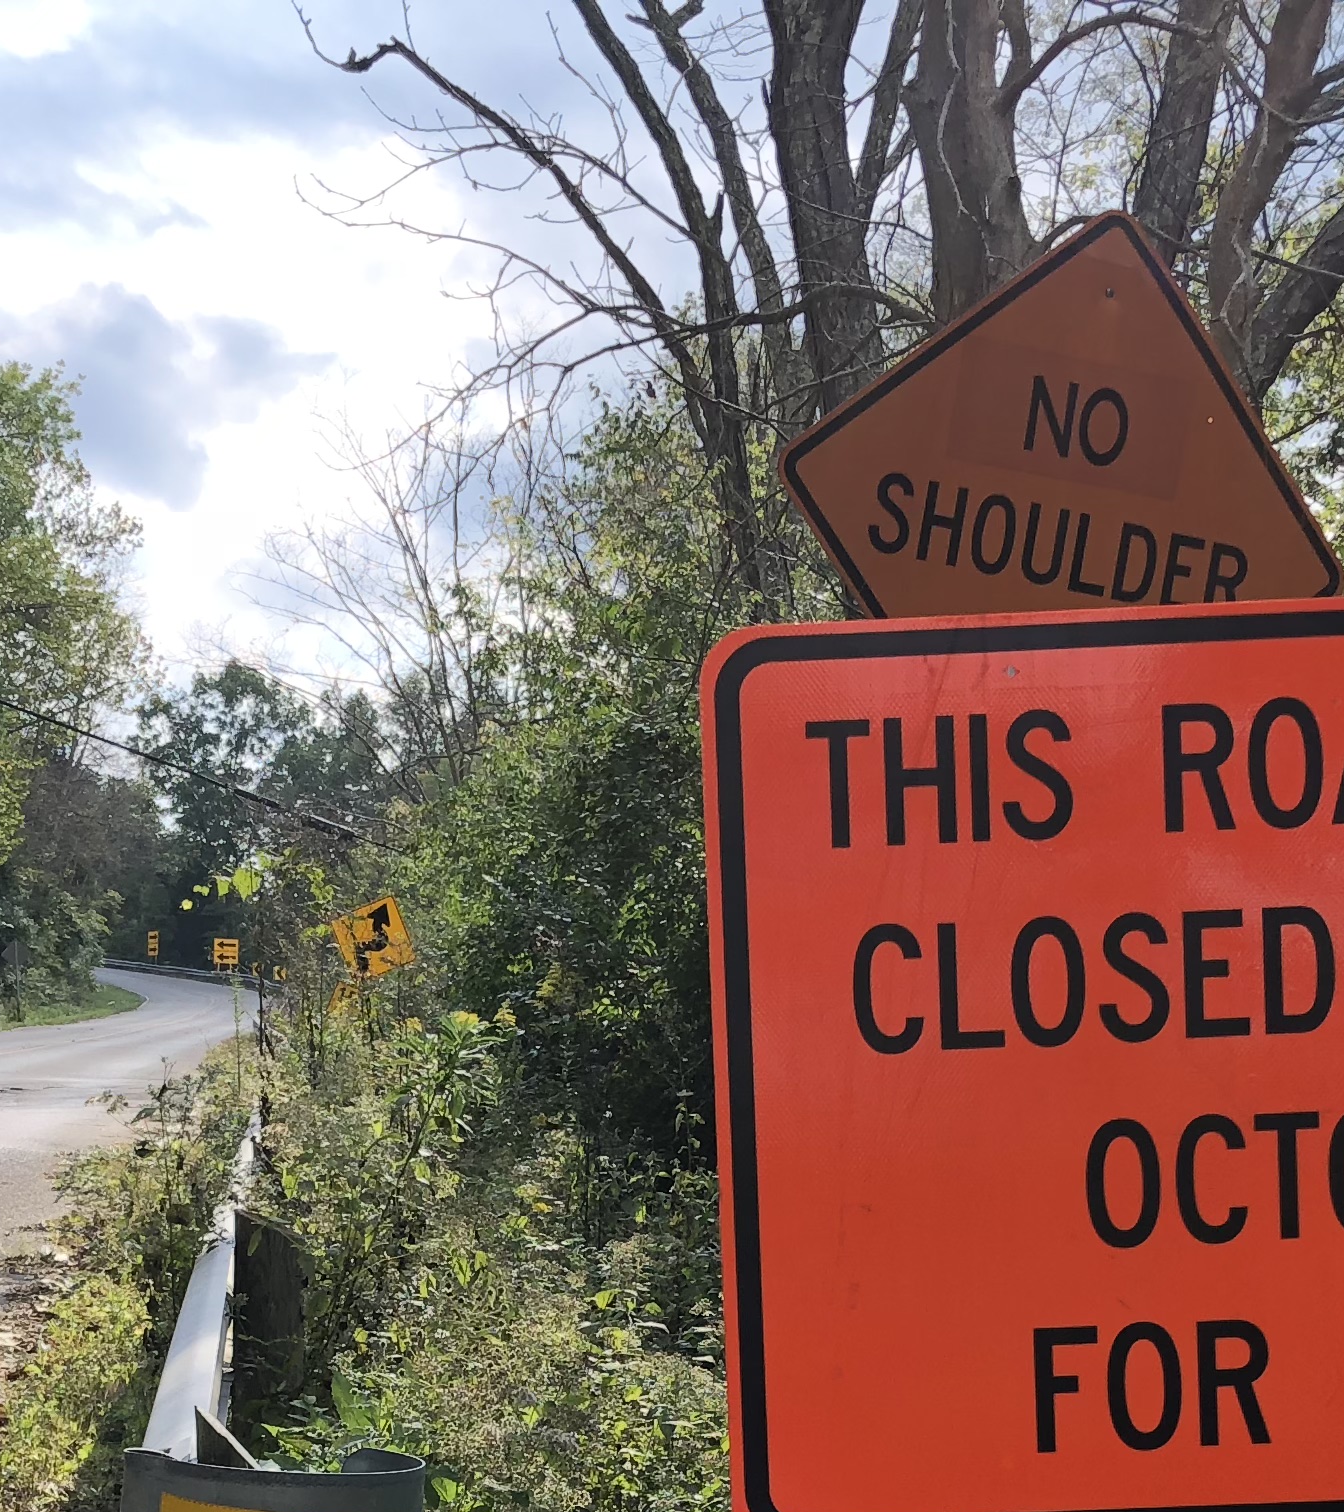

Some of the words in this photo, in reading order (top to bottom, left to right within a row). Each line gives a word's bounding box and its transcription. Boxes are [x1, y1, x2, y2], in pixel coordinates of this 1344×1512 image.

[1023, 375, 1129, 467] NO
[867, 472, 1249, 606] SHOULDER
[804, 708, 1074, 849] THIS
[852, 905, 1337, 1056] CLOSED
[1032, 1319, 1273, 1454] FOR
